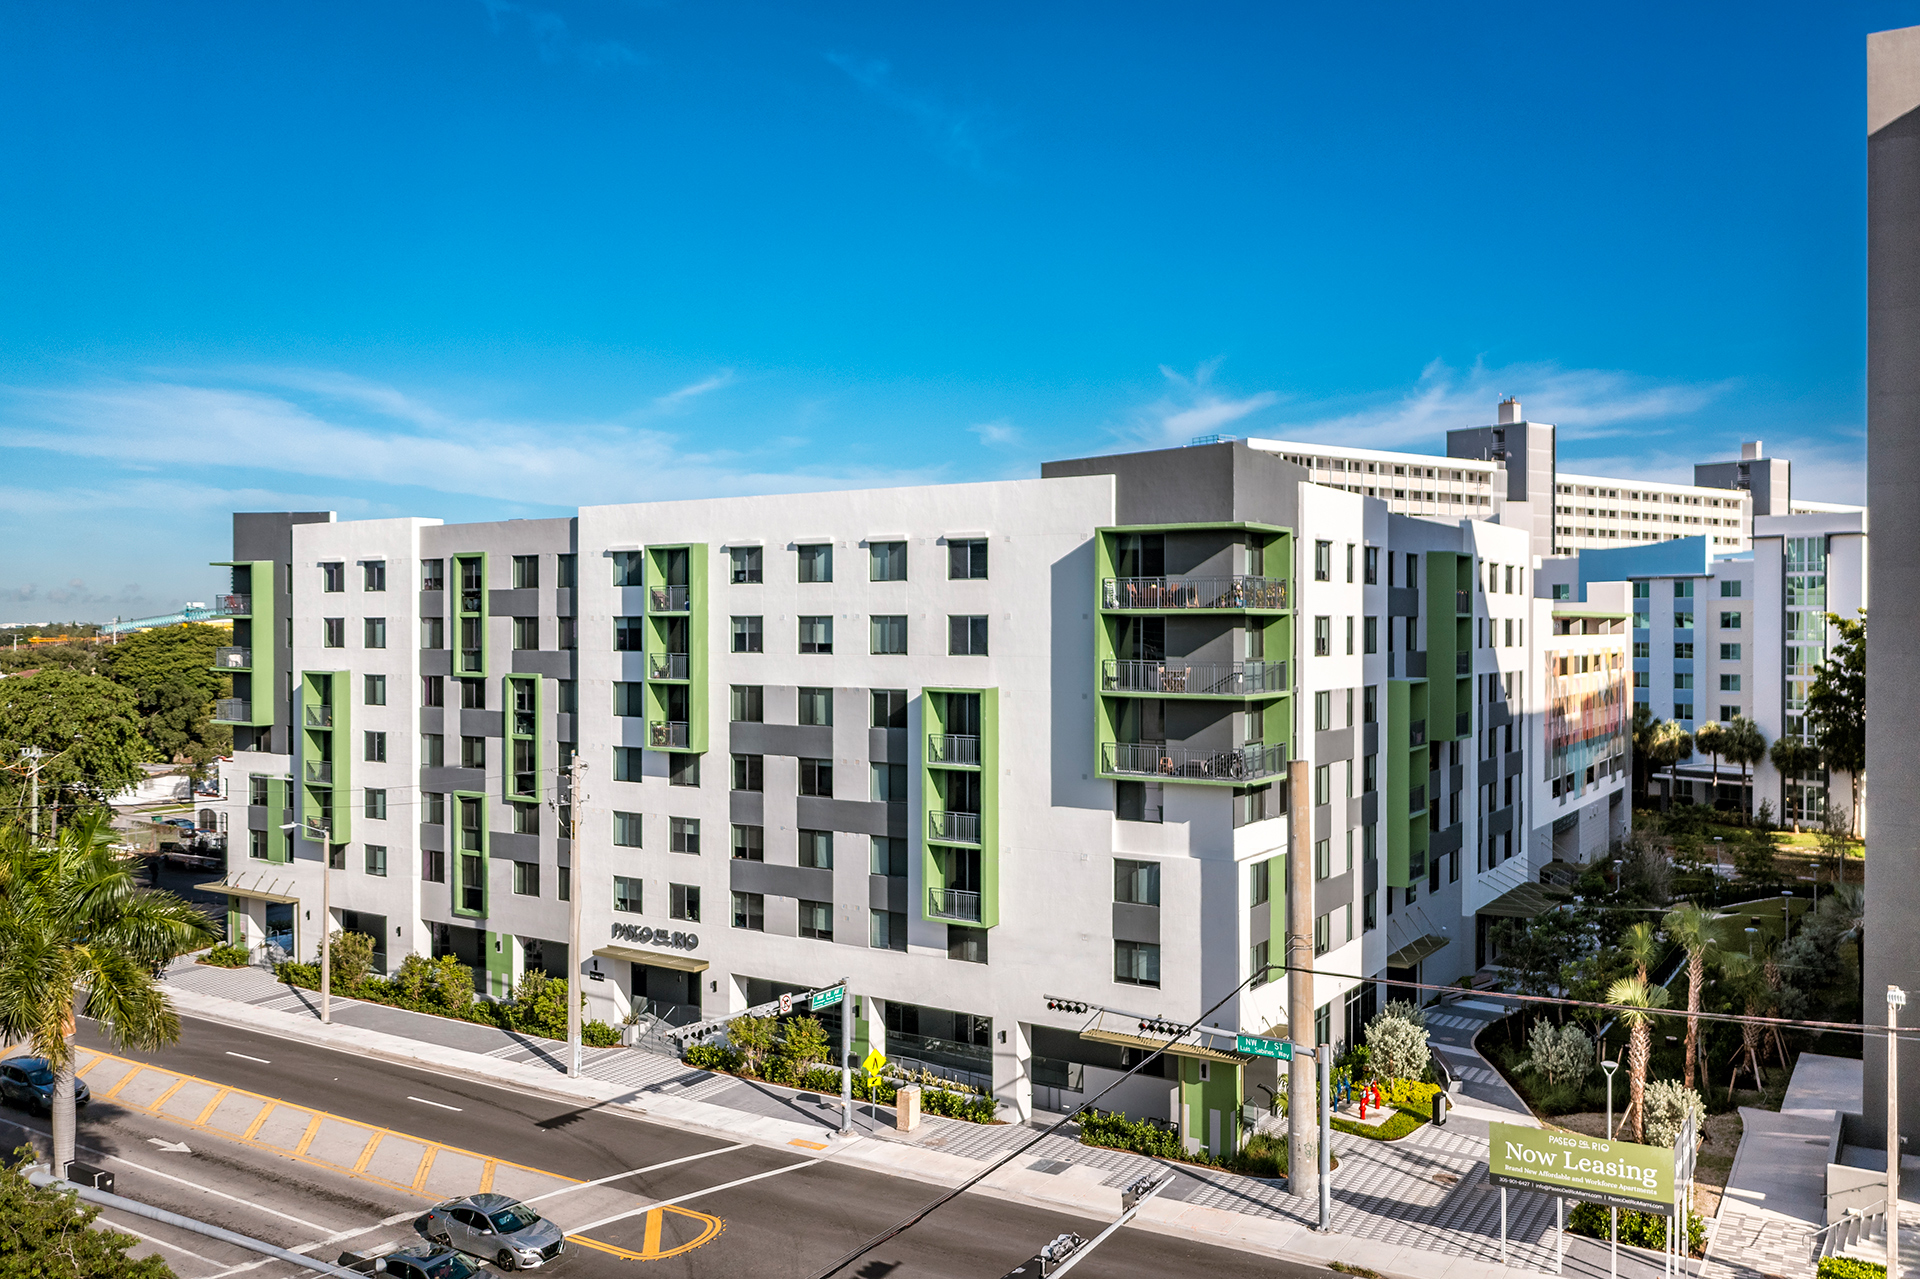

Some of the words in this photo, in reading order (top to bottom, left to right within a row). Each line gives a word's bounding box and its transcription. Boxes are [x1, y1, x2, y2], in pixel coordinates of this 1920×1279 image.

[611, 922, 653, 944] PASEO
[671, 931, 699, 951] RIO
[1245, 1038, 1257, 1046] NW
[1262, 1039, 1269, 1049] 7
[1274, 1042, 1283, 1050] ST
[1278, 1051, 1289, 1059] Way
[1548, 1135, 1577, 1148] PASEO
[1591, 1142, 1610, 1153] RIO
[1505, 1141, 1557, 1167] Now
[1563, 1150, 1658, 1189] Leasing
[1504, 1164, 1523, 1173] Brand
[1524, 1167, 1537, 1176] New
[1538, 1170, 1571, 1181] Affordable
[1584, 1177, 1618, 1189] Workforce
[1618, 1183, 1658, 1195] Apartments
